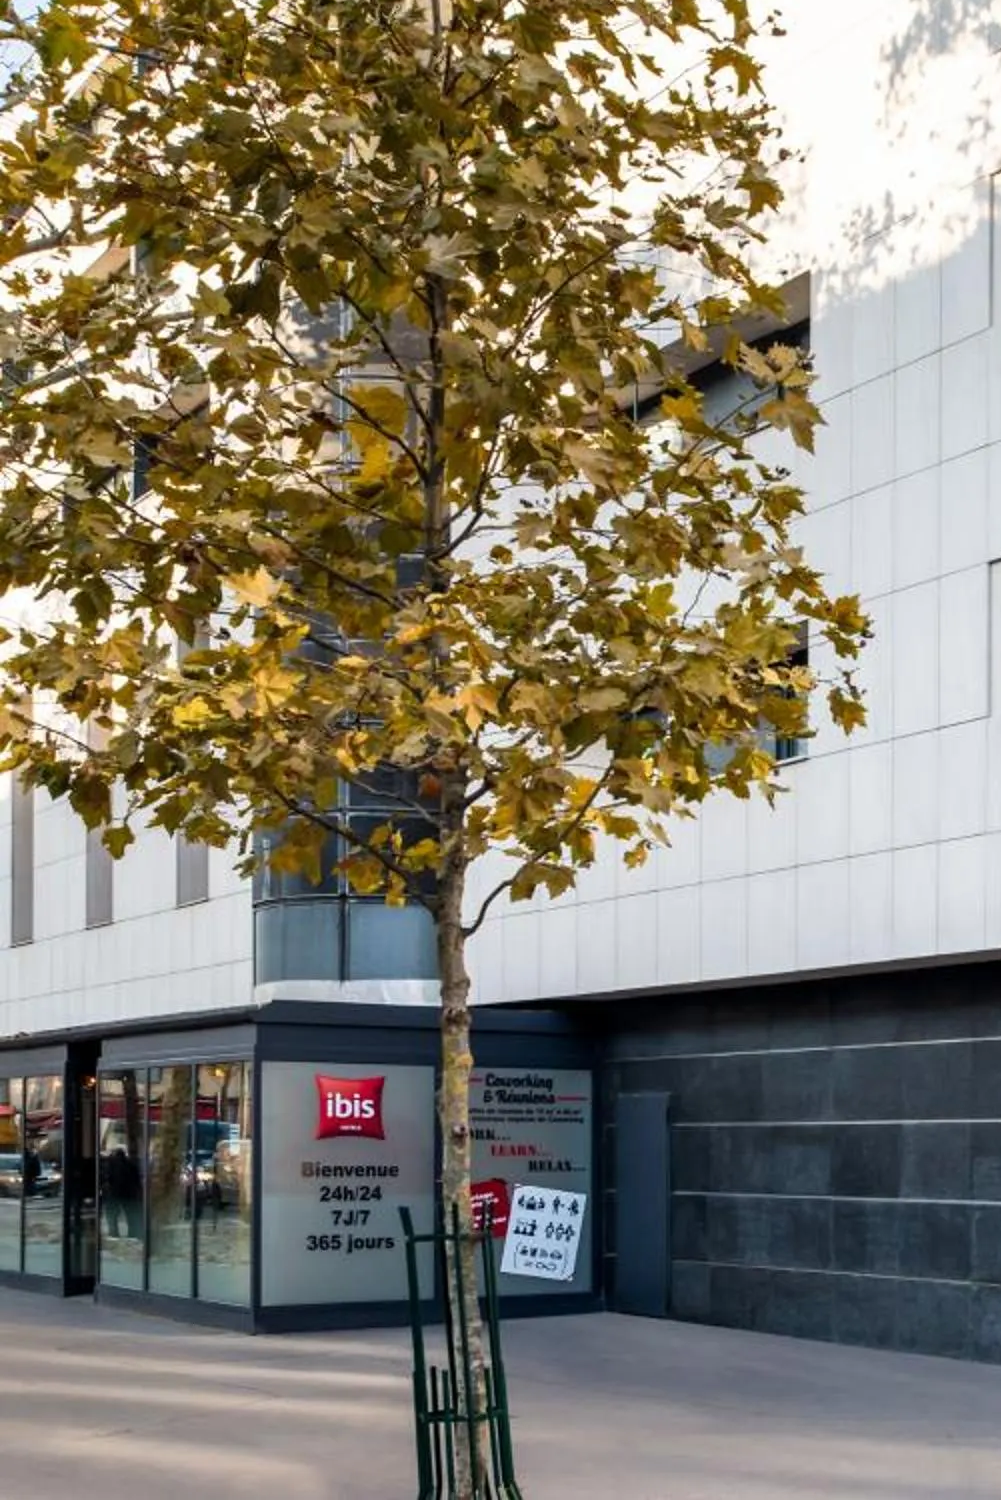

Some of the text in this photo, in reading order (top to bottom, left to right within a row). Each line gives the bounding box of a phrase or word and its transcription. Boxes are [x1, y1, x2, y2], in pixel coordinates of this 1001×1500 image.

[485, 1073, 553, 1092] Coworking
[326, 1092, 375, 1119] ibis
[302, 1161, 399, 1178] Bienvenue
[320, 1185, 382, 1202] 24h/24
[332, 1209, 371, 1226] 7J/7
[306, 1234, 395, 1254] 365 jours
